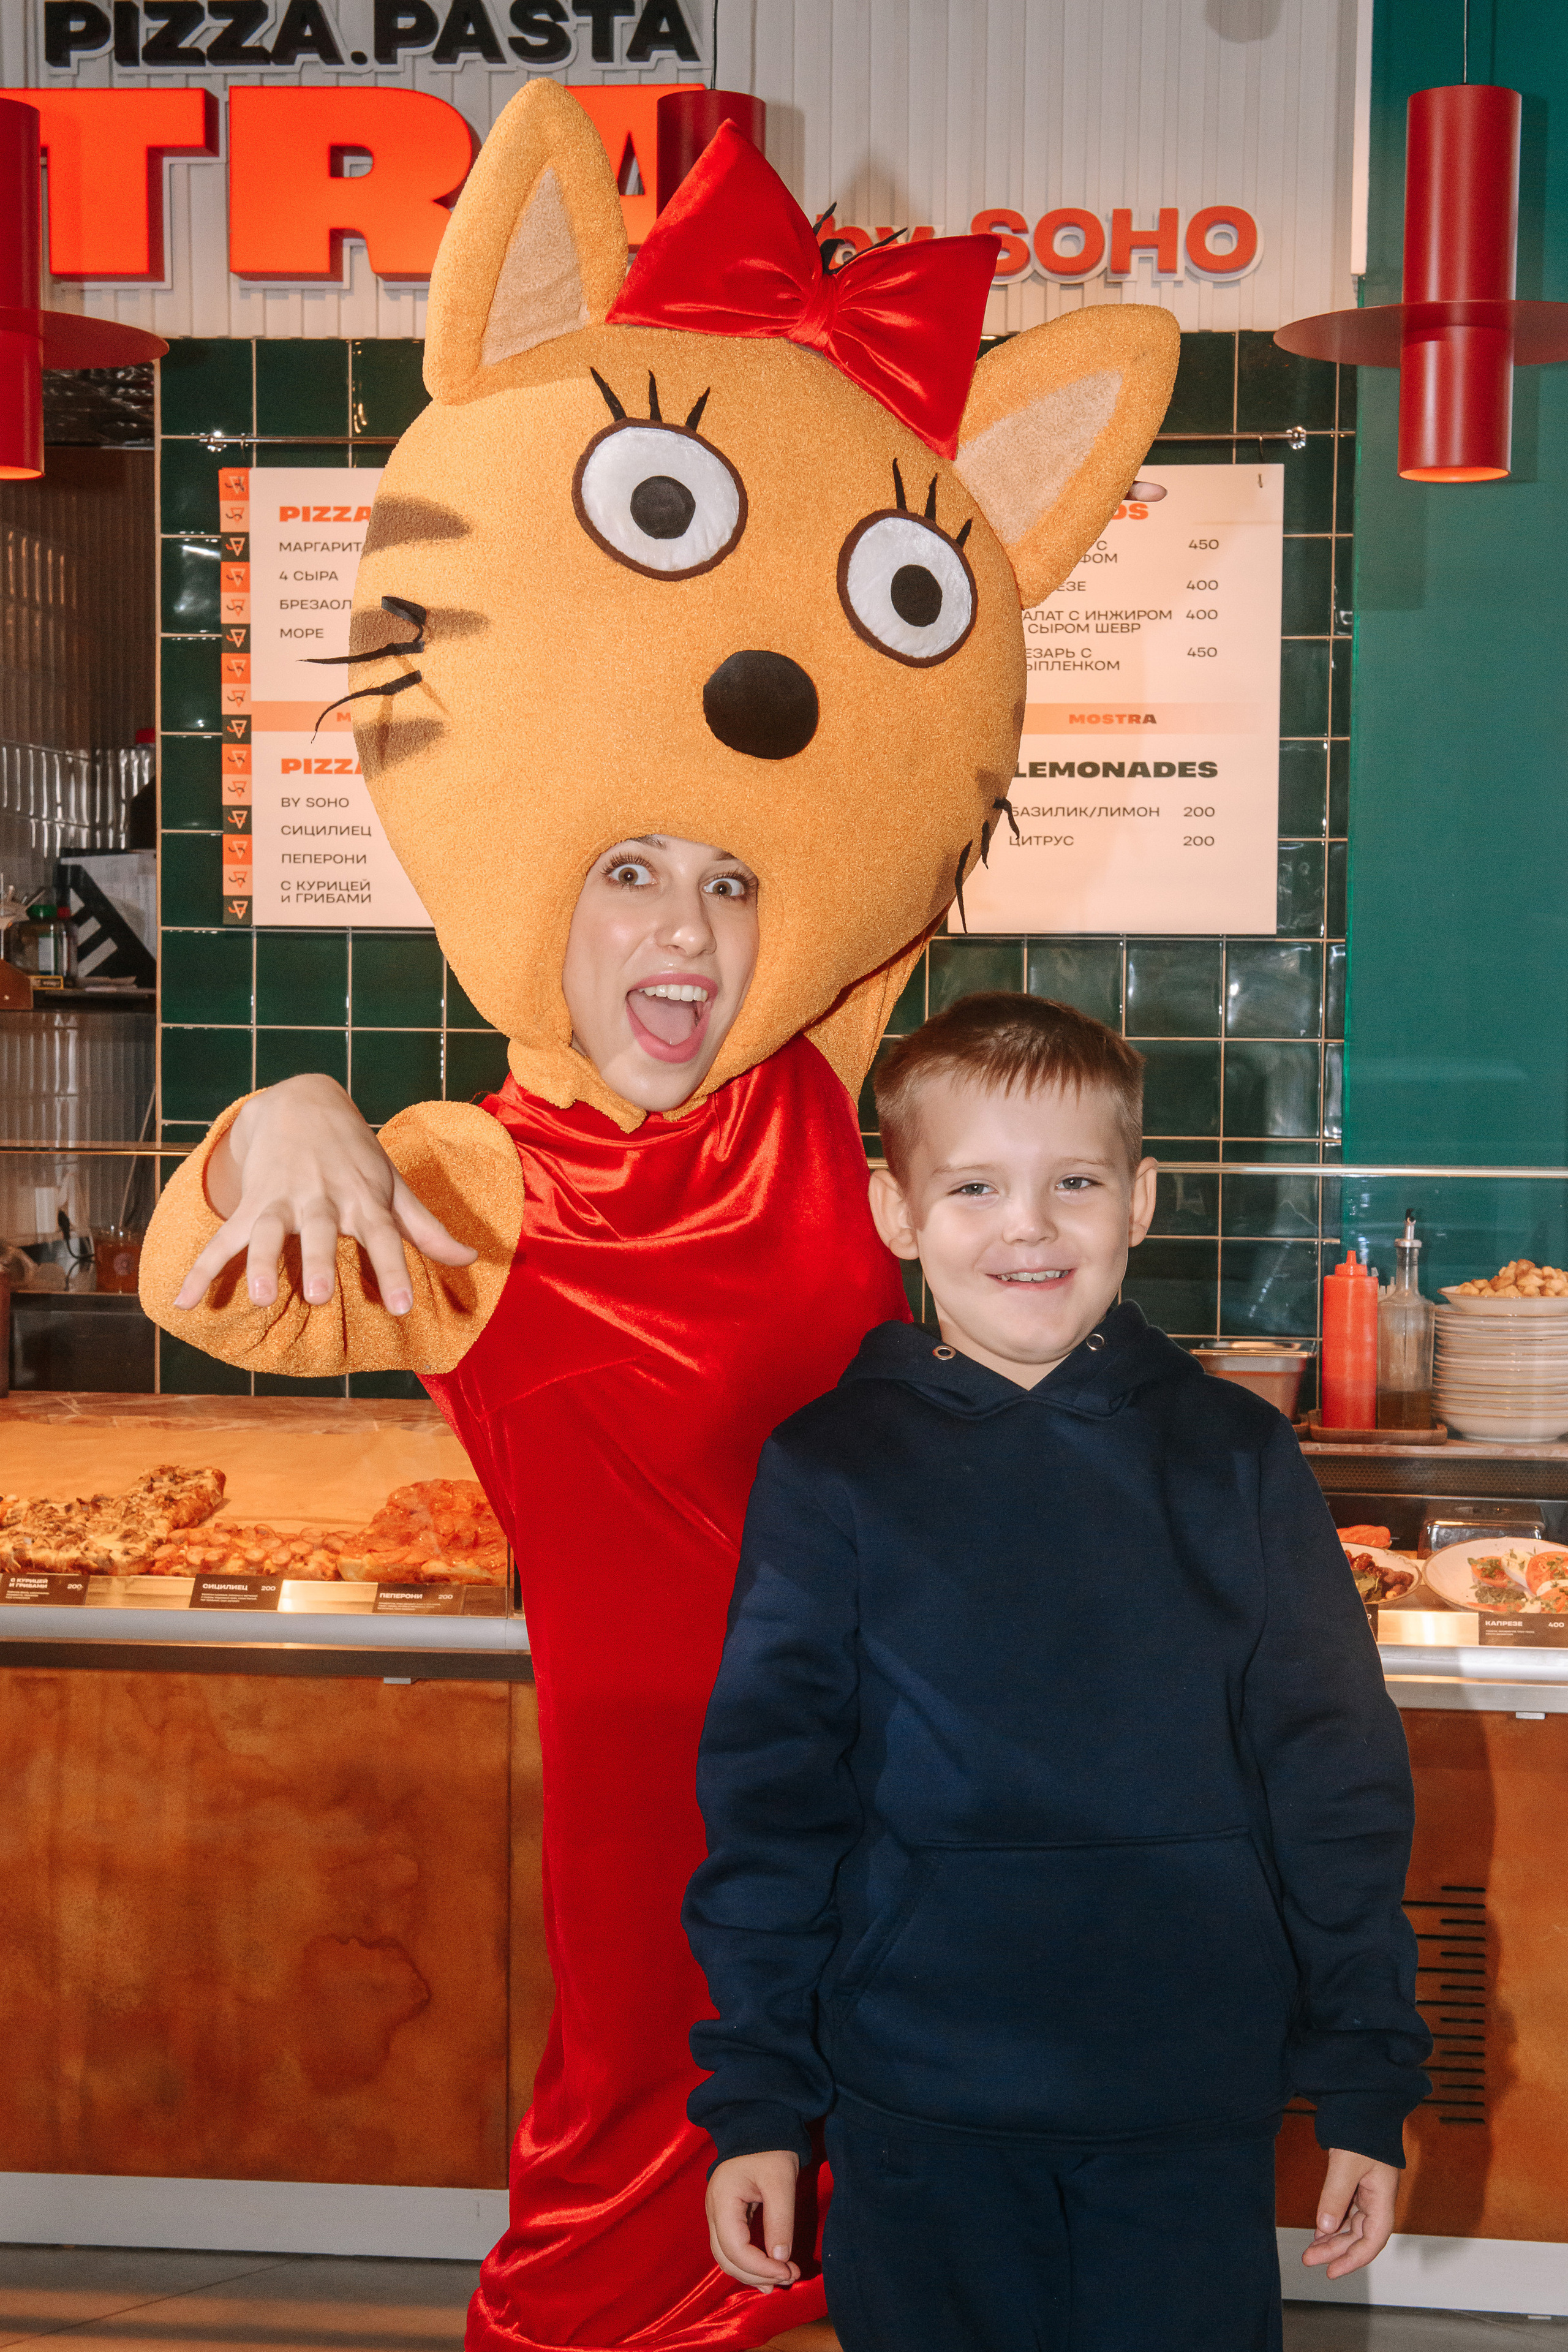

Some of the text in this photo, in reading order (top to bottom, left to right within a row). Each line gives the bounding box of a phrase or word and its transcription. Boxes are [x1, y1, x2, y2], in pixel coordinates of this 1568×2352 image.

[45, 0, 700, 66] PIZZA.PASTA
[971, 206, 1257, 276] SOHO
[279, 506, 372, 522] PIZZA
[279, 541, 362, 552] МАРГАРИТ
[1188, 539, 1219, 550] 450
[279, 571, 338, 581] 4 СЫРА
[1186, 579, 1219, 590] 400
[280, 600, 352, 610] БРЕЗАОЛ
[1023, 609, 1218, 621] АЛАТ С ИНЖИРОМ 400
[280, 628, 324, 638] МОРЕ
[1028, 623, 1140, 634] СЫРОМ ШЕВР
[1026, 647, 1218, 658] ЕЗАРЬ С 450
[1027, 661, 1120, 671] ЫПЛЕНКОМ
[1069, 714, 1157, 725] MOSTRA
[1014, 761, 1218, 778] LEMONADES
[281, 797, 349, 808] BY SOHO
[1012, 806, 1215, 818] БАЗИЛИК/ЛИМОН 200
[281, 825, 371, 837] СИЦИЛИЕЦ
[1009, 835, 1215, 847] ЦИТРУС 200
[281, 854, 367, 864] ПЕПЕРОНИ
[281, 879, 370, 892] С КУРИЦЕЙ
[296, 894, 371, 903] ГРИБАМИ
